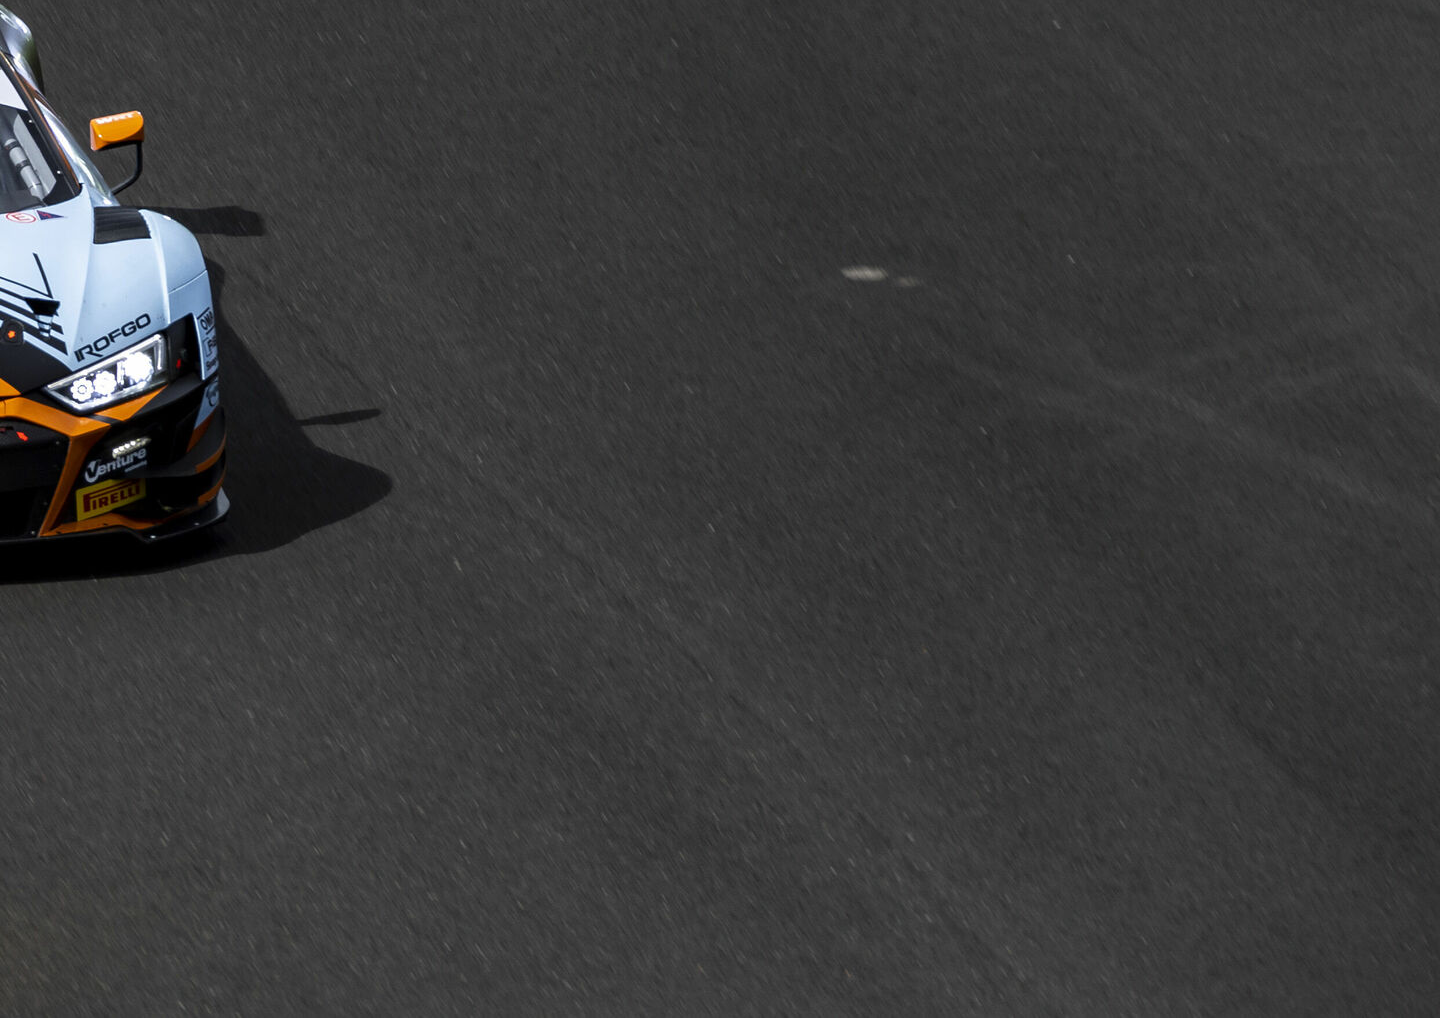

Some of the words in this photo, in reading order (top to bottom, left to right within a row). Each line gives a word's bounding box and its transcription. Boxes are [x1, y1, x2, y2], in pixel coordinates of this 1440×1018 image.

[73, 313, 151, 363] IROFGO
[84, 448, 148, 483] Venture
[82, 479, 141, 514] PIRELLI
